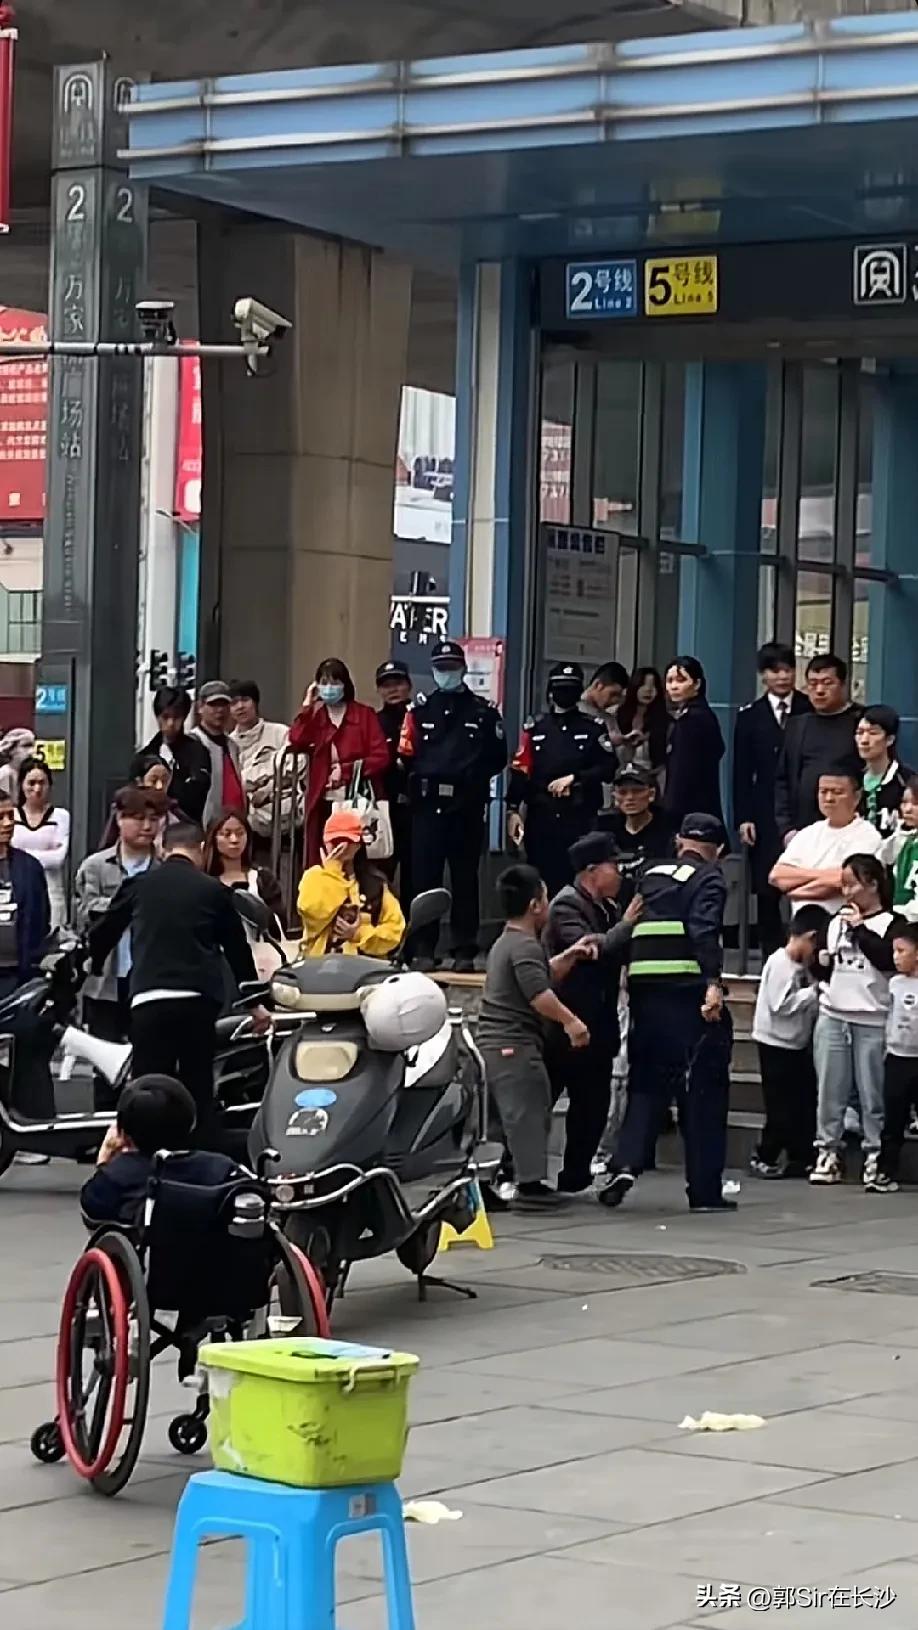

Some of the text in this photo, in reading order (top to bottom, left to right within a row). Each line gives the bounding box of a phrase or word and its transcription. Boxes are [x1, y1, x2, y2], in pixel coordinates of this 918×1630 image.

[68, 184, 86, 221] 2
[116, 187, 133, 223] 2
[570, 267, 633, 311] 2号线
[649, 261, 714, 306] 5号线
[595, 297, 622, 309] Line
